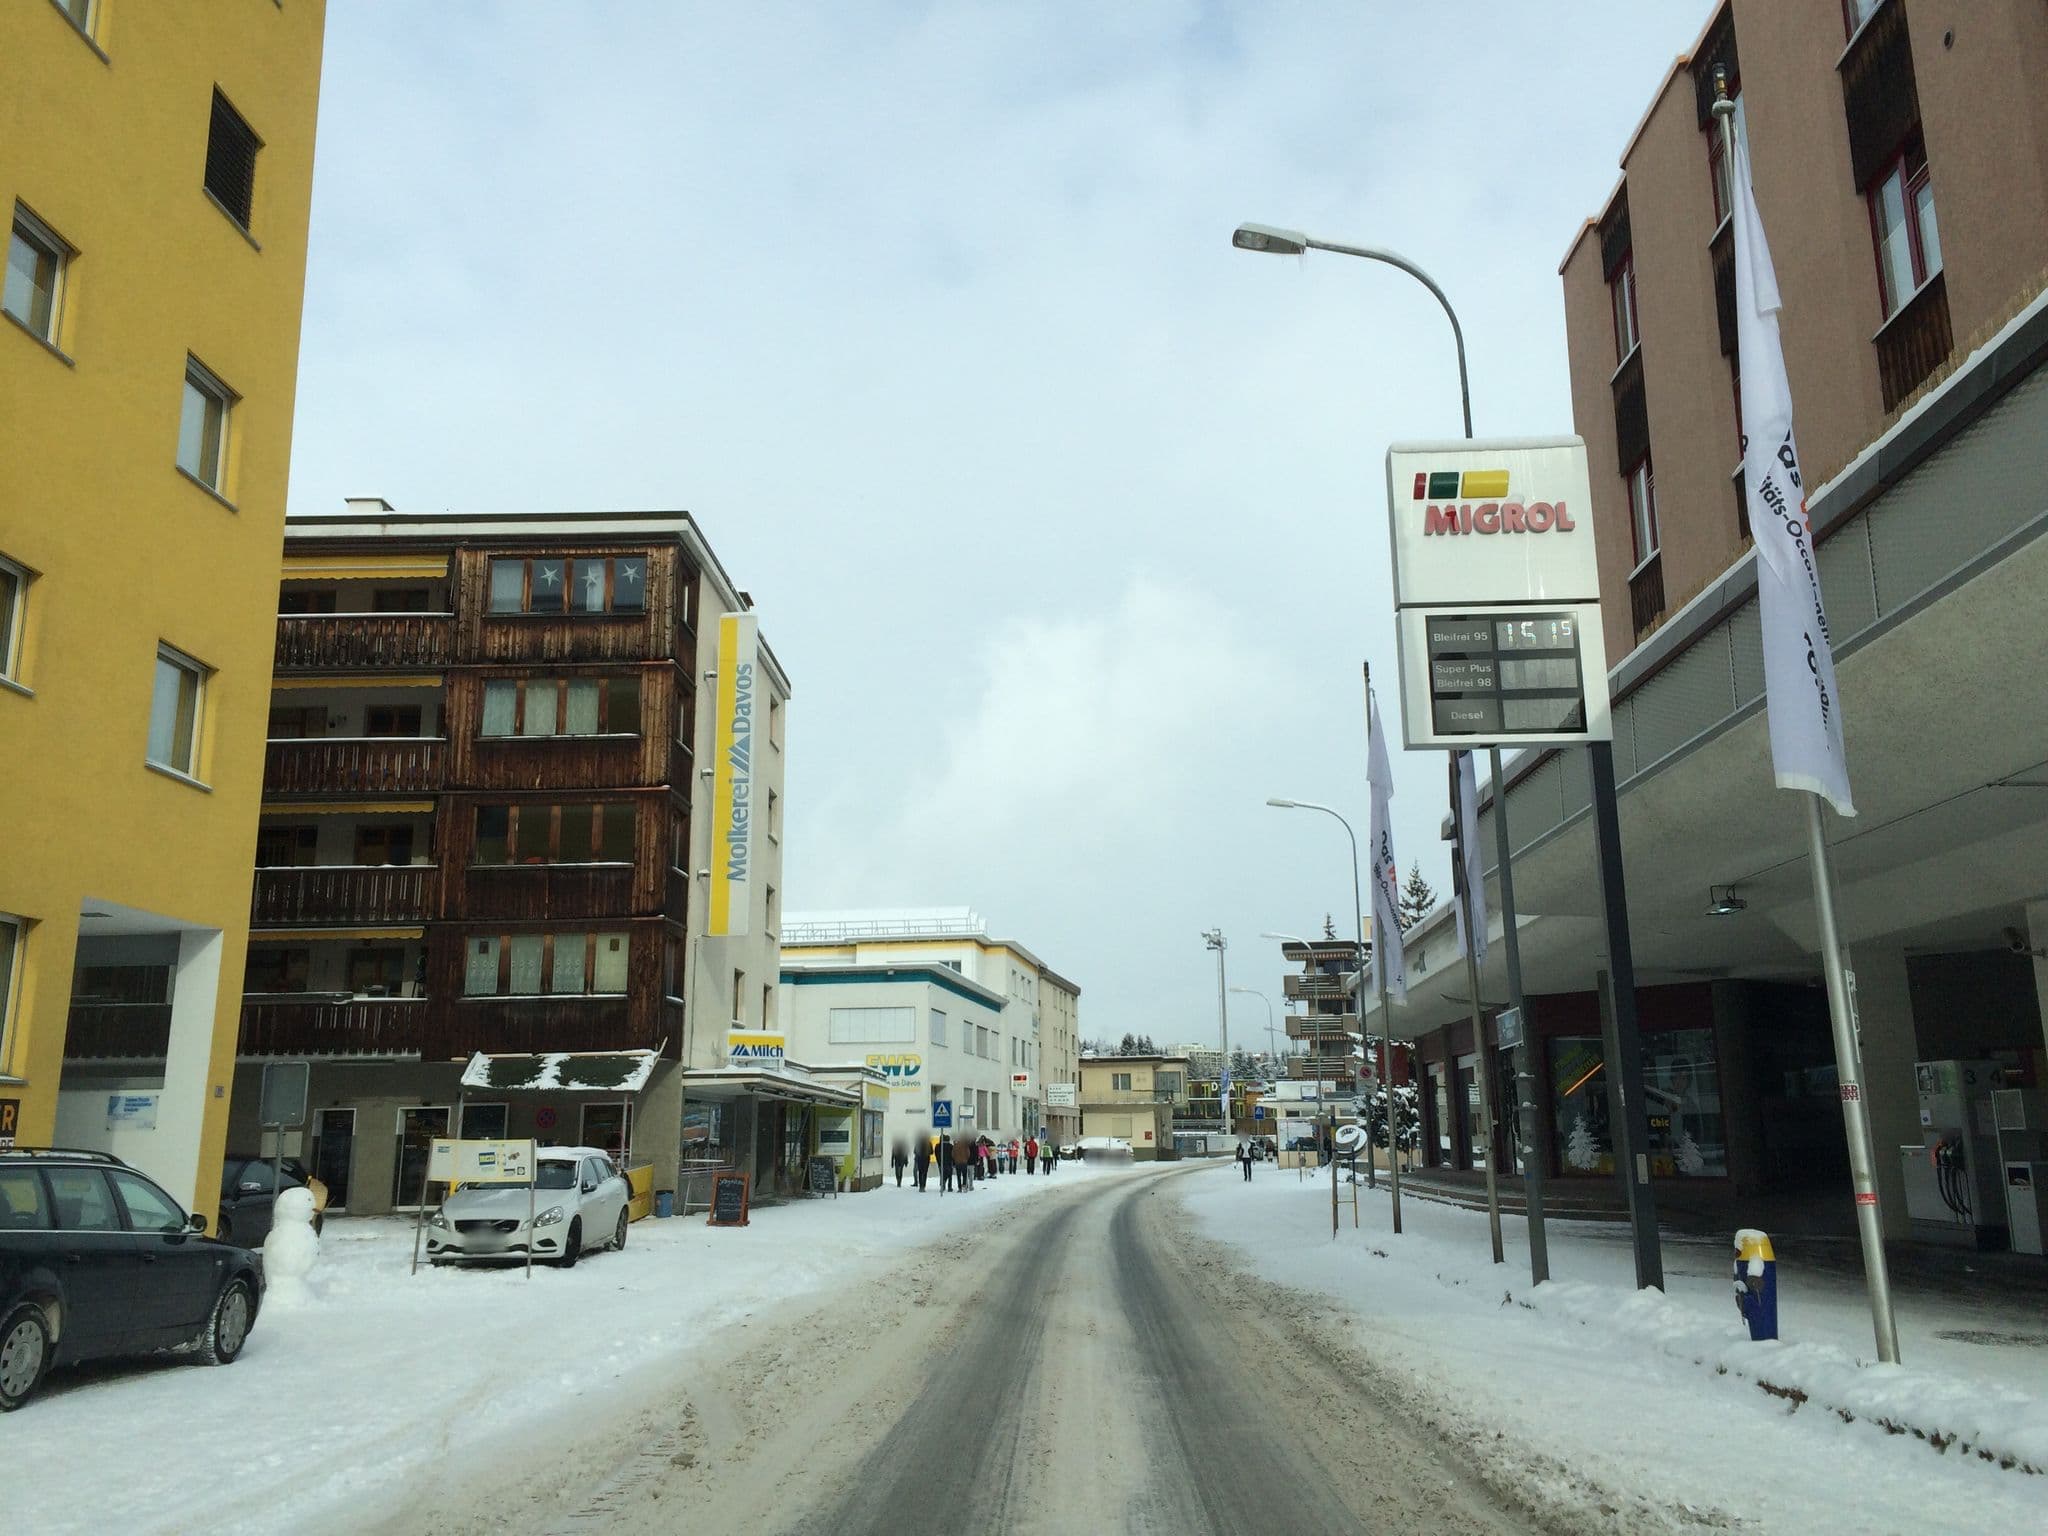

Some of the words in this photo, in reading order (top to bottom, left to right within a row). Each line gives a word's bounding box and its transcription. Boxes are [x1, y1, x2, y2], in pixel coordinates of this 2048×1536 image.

[1424, 502, 1575, 536] MIGROL
[1433, 633, 1471, 642] Bleifrei
[1474, 632, 1488, 641] 95
[1435, 664, 1466, 674] Super
[1470, 663, 1492, 673] Plus
[1437, 678, 1474, 688] Bleifrei
[1477, 678, 1492, 687] 98
[731, 663, 752, 733] Davos
[1451, 710, 1483, 721] Diesel
[726, 778, 750, 882] Molkerei
[751, 1044, 784, 1058] Milch
